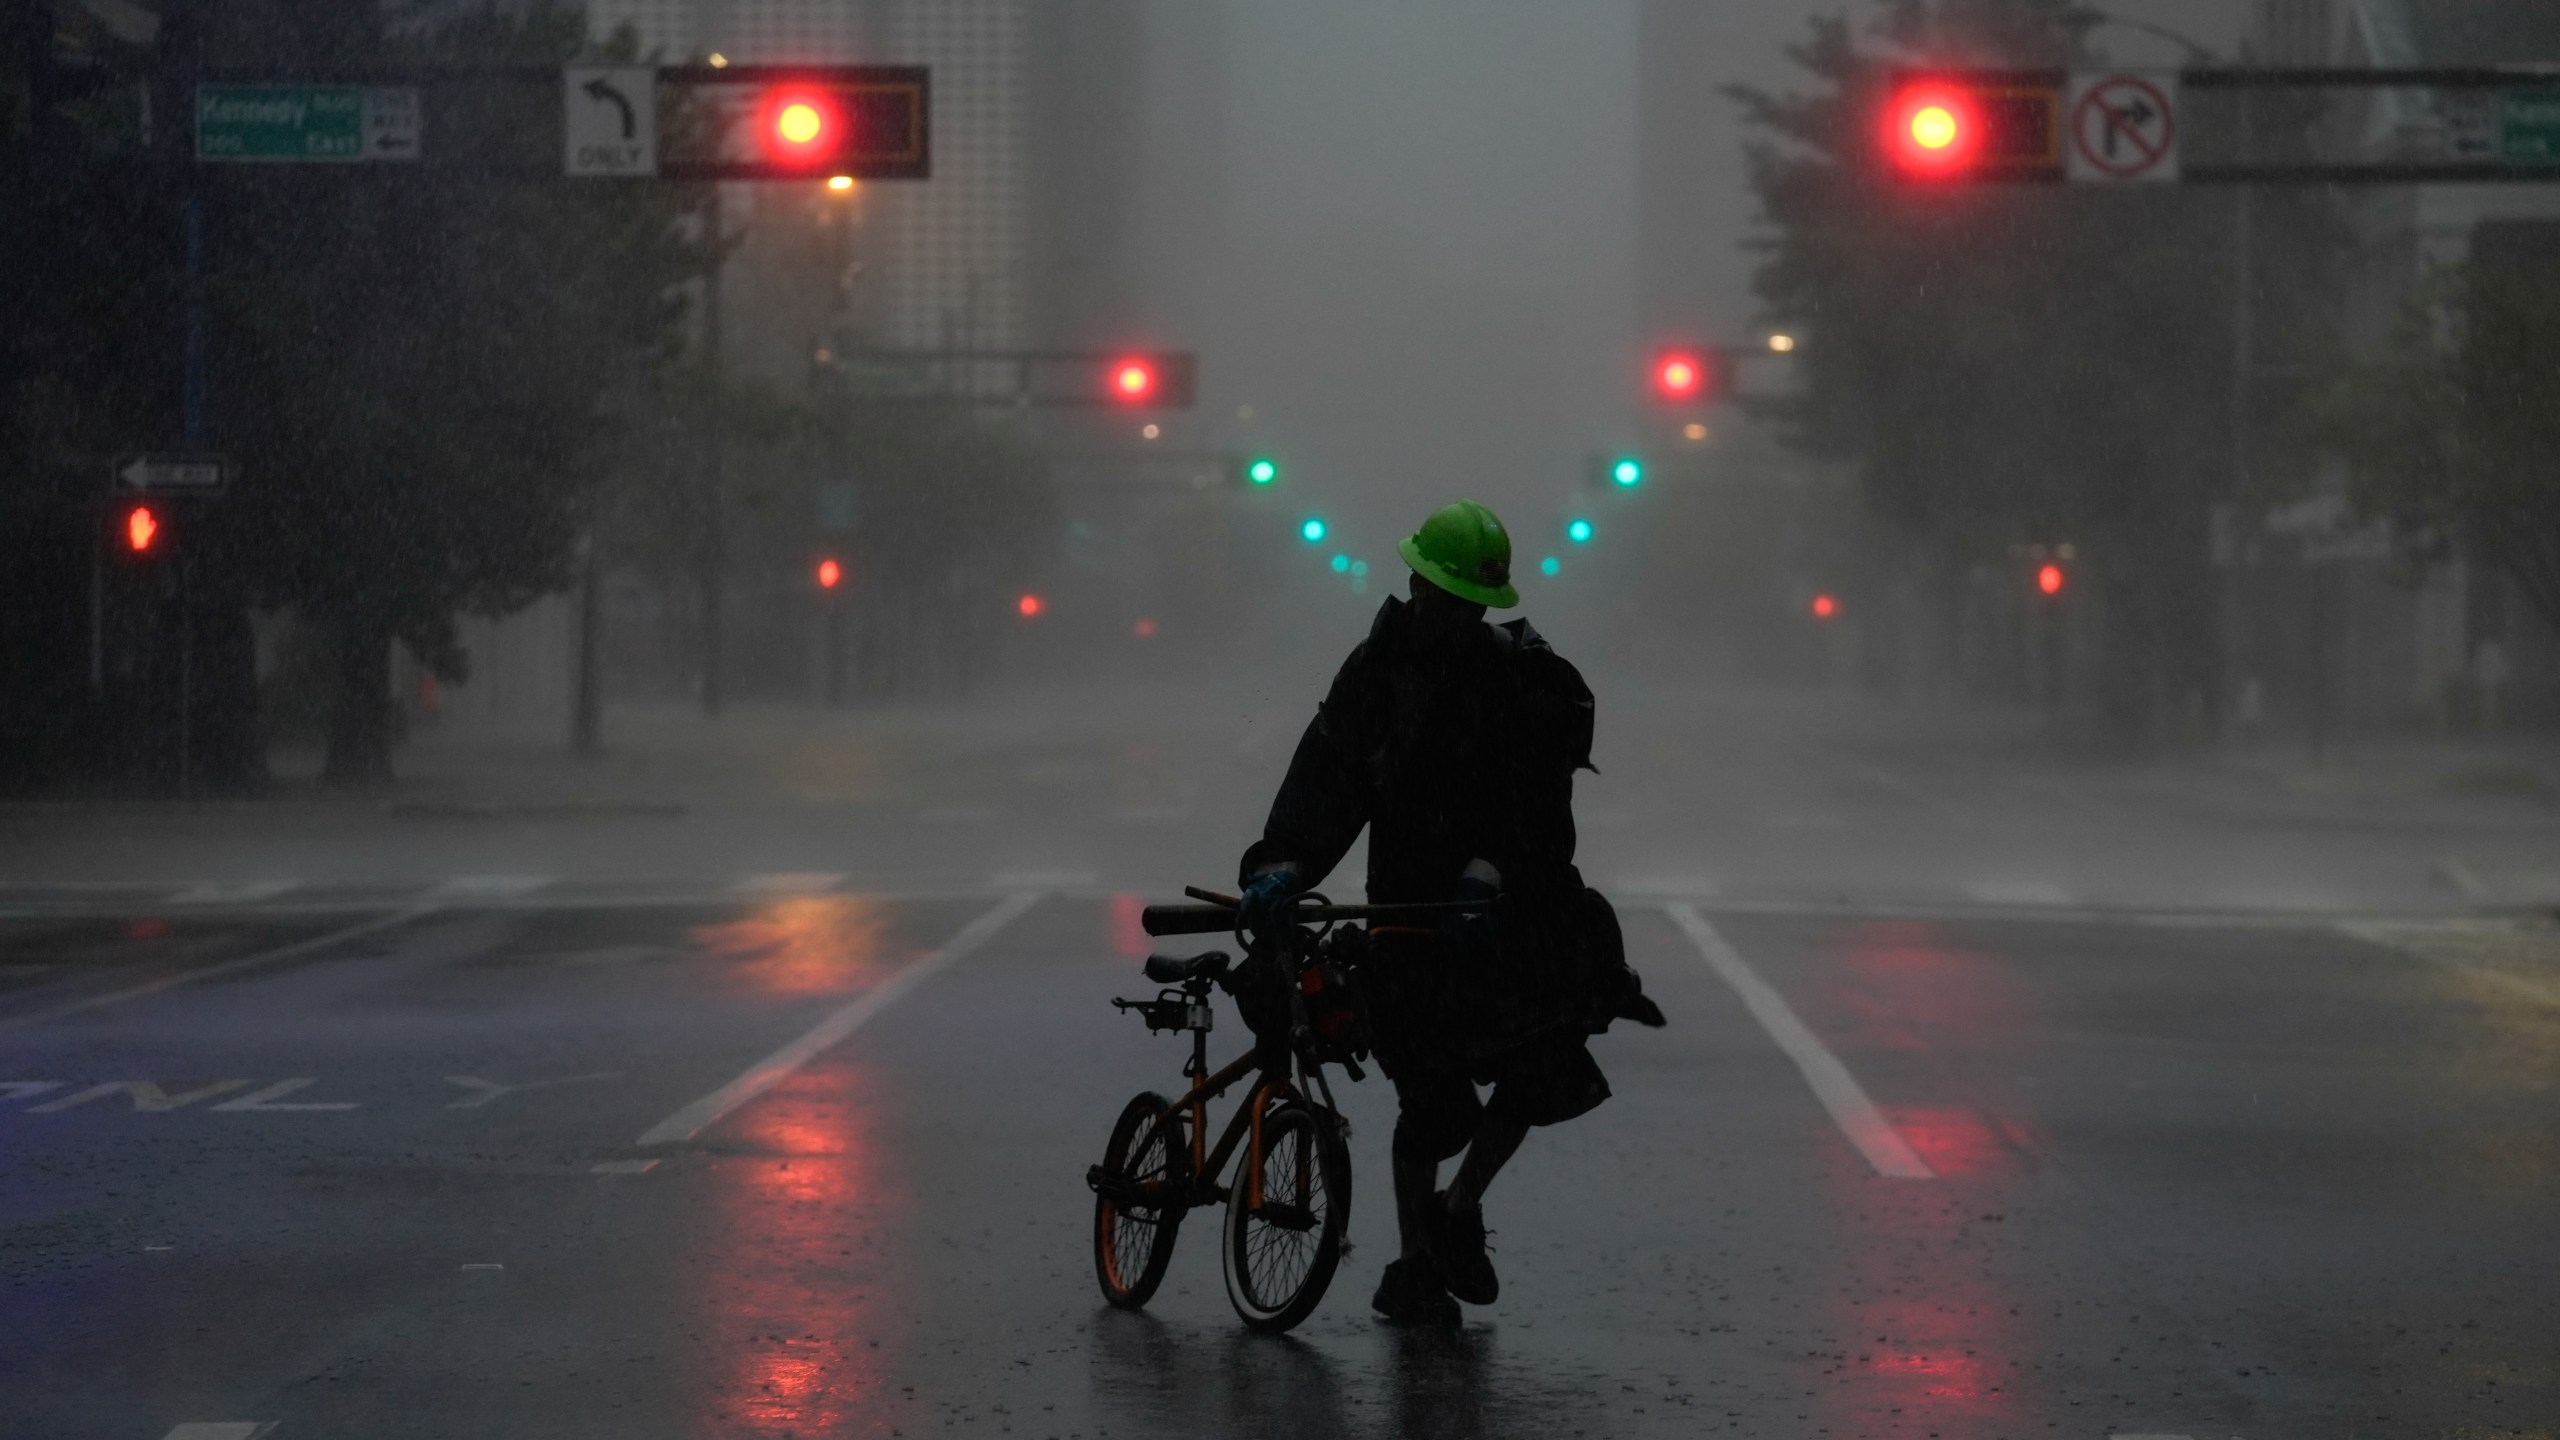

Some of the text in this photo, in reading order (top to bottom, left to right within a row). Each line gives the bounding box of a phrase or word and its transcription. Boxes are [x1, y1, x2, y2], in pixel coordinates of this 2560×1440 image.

[202, 95, 306, 129] Kennedy
[306, 131, 358, 153] East
[577, 144, 643, 168] ONLY
